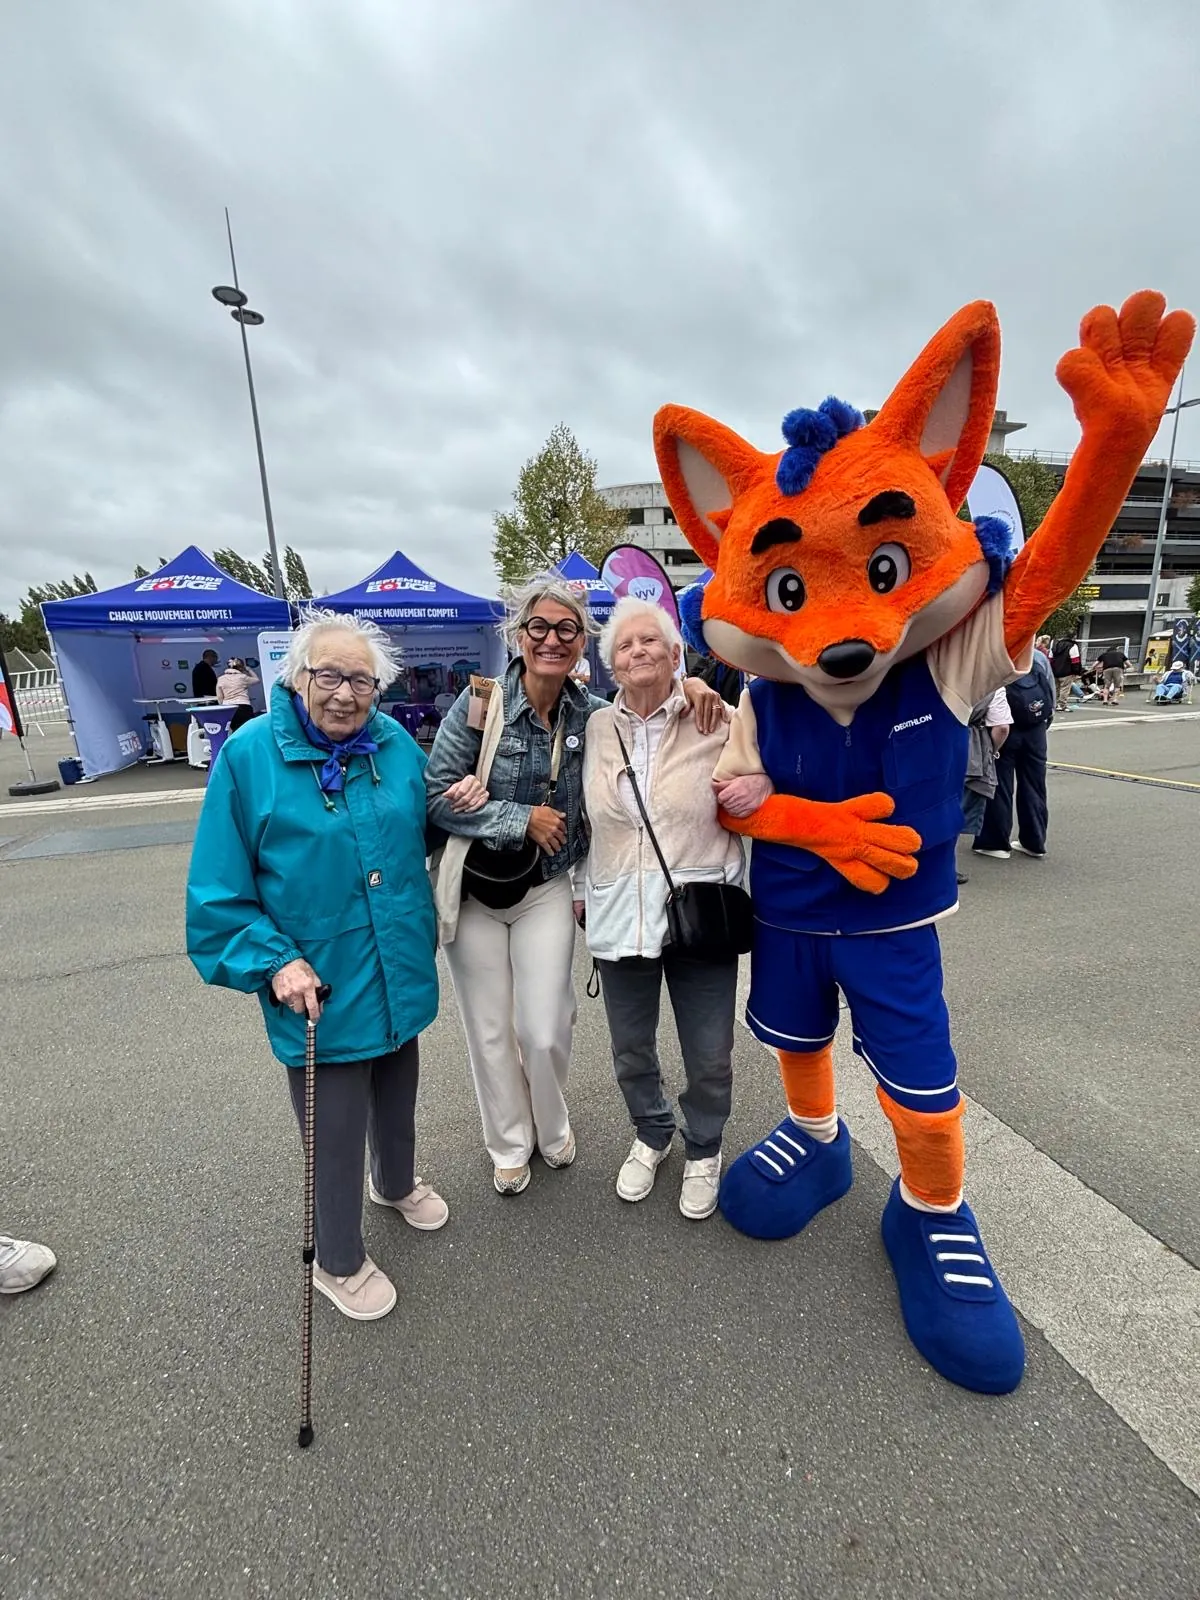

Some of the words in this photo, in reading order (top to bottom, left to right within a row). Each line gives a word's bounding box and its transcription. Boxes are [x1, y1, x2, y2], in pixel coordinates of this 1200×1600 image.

[109, 611, 143, 622] CHAQUE
[145, 610, 194, 621] MOUVEMENT
[196, 610, 228, 620] COMPTE
[354, 609, 382, 619] CHAQUE
[383, 609, 426, 618] MOUVEMENT
[427, 609, 454, 618] COMPTE
[893, 713, 933, 732] DECATHLON
